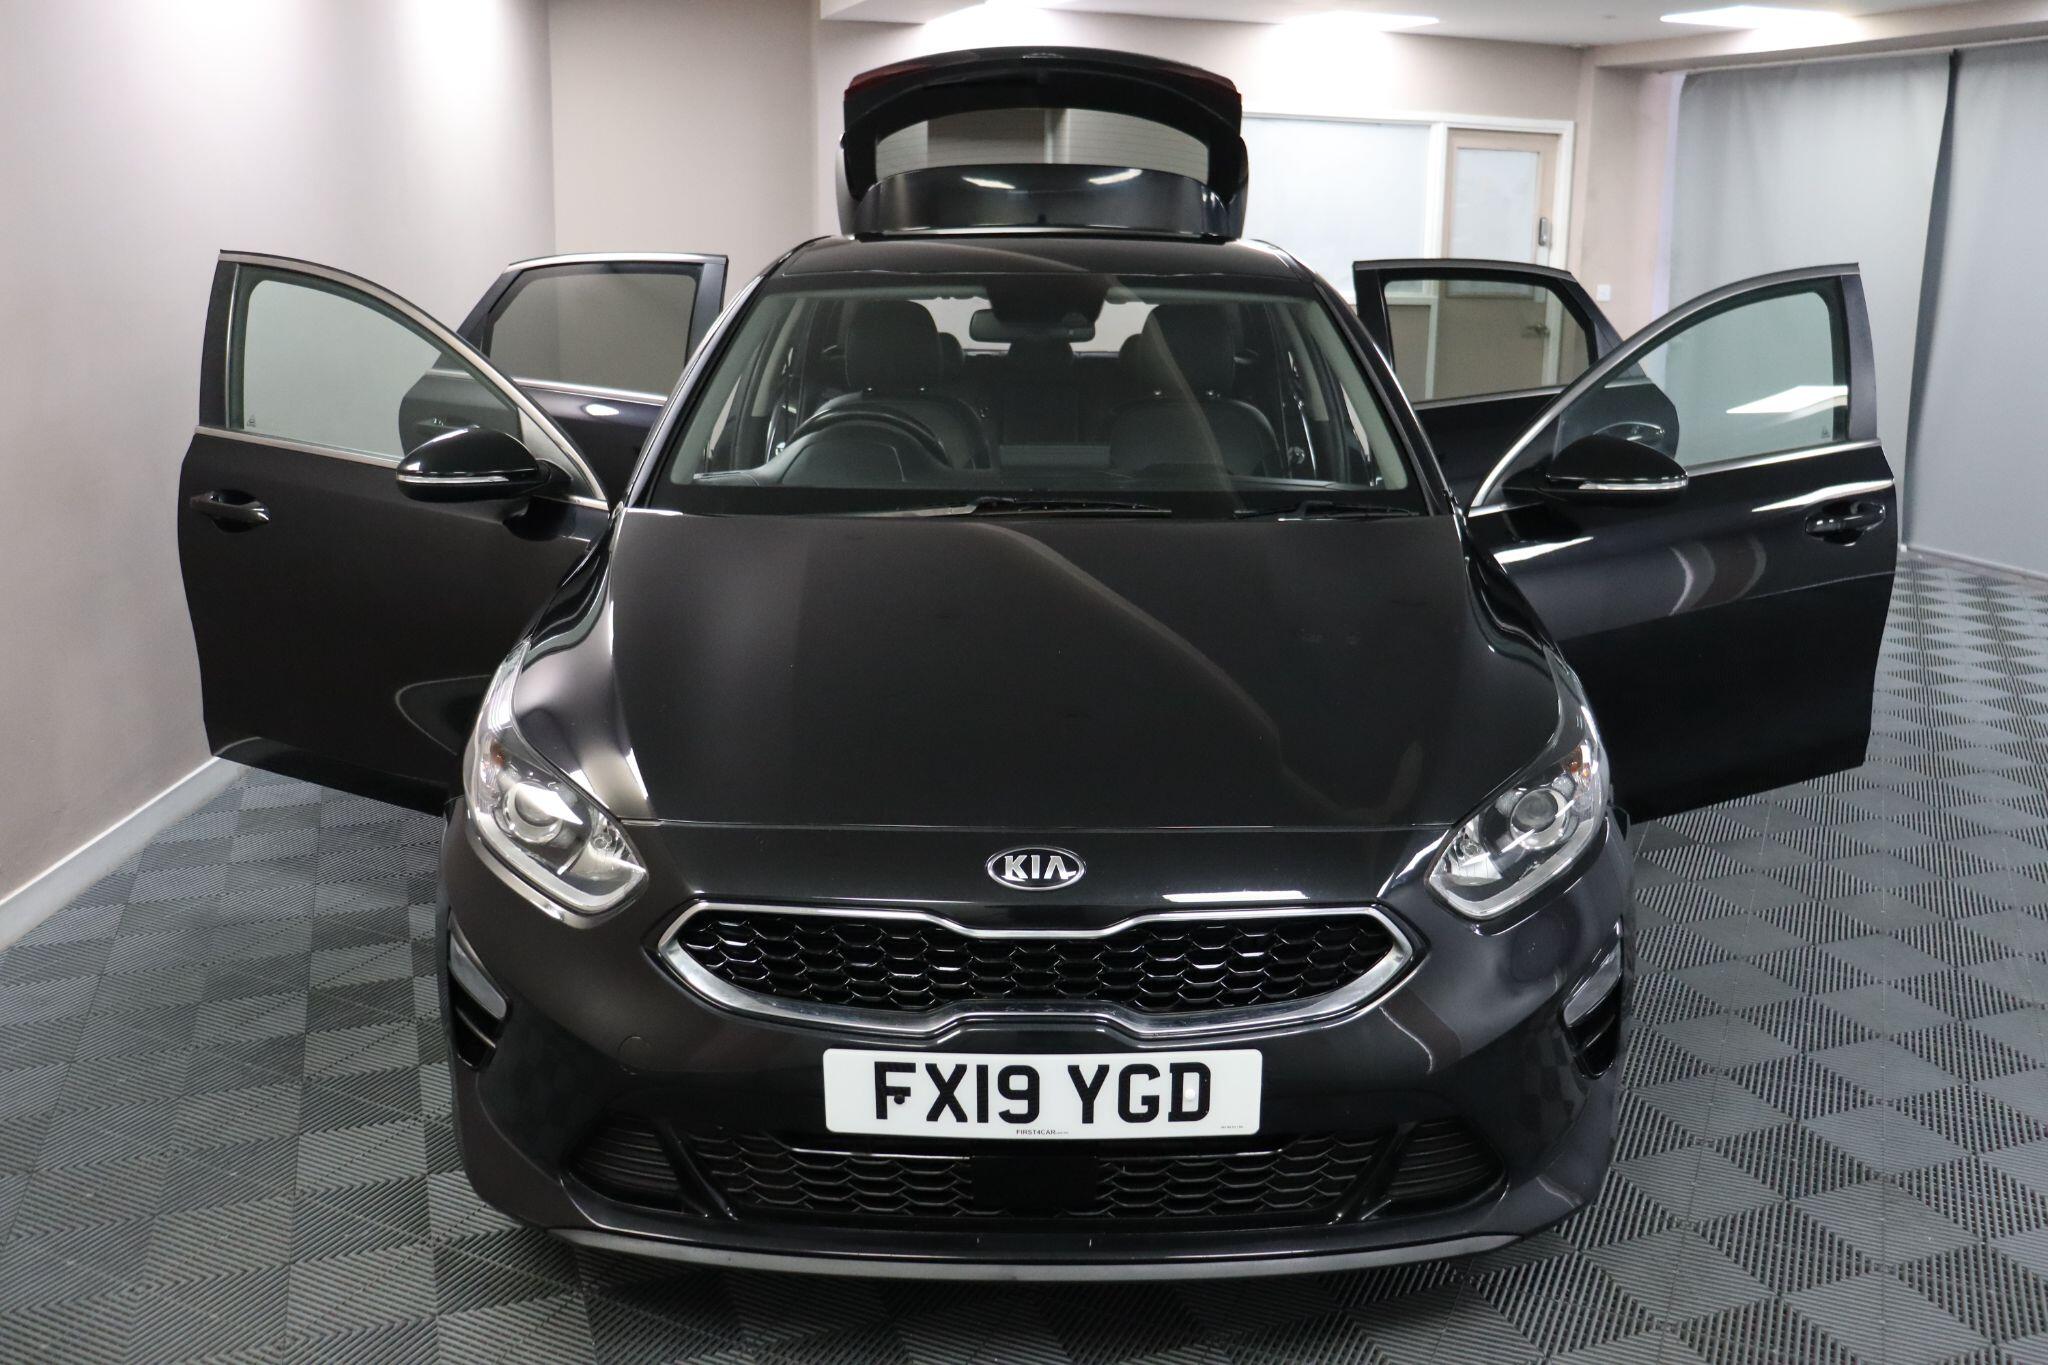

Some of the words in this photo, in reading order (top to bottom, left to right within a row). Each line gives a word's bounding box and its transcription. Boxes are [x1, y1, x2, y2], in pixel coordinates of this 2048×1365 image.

[1001, 854, 1077, 882] KIA
[874, 1061, 1040, 1124] FX19
[1067, 1061, 1212, 1124] YGD
